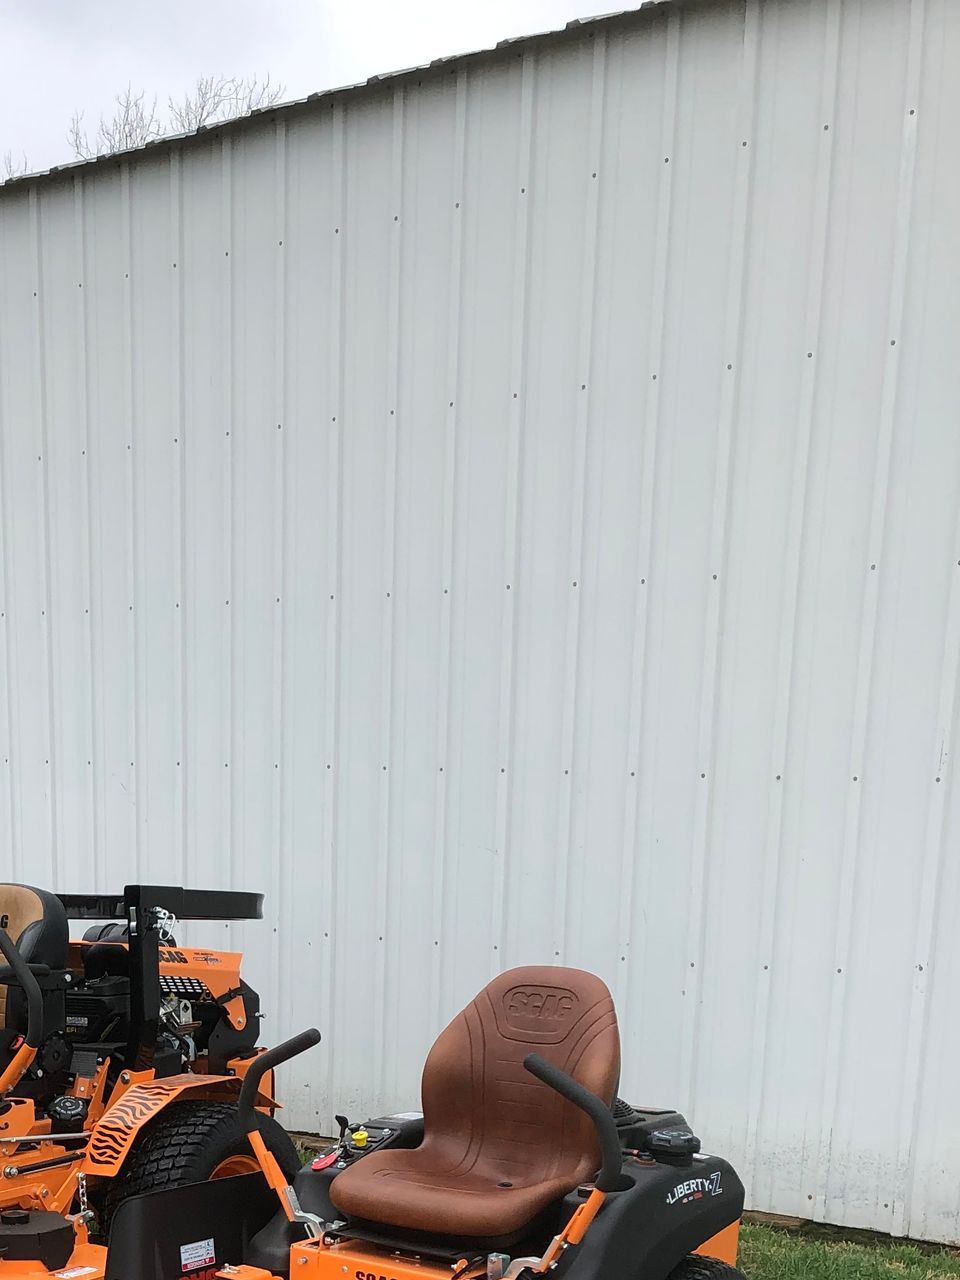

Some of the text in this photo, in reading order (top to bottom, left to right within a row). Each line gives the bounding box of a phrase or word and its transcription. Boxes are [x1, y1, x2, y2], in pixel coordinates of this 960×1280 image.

[159, 950, 188, 964] CAG
[509, 991, 574, 1019] SCAG
[667, 1178, 710, 1205] LIBERTY
[711, 1171, 723, 1196] Z
